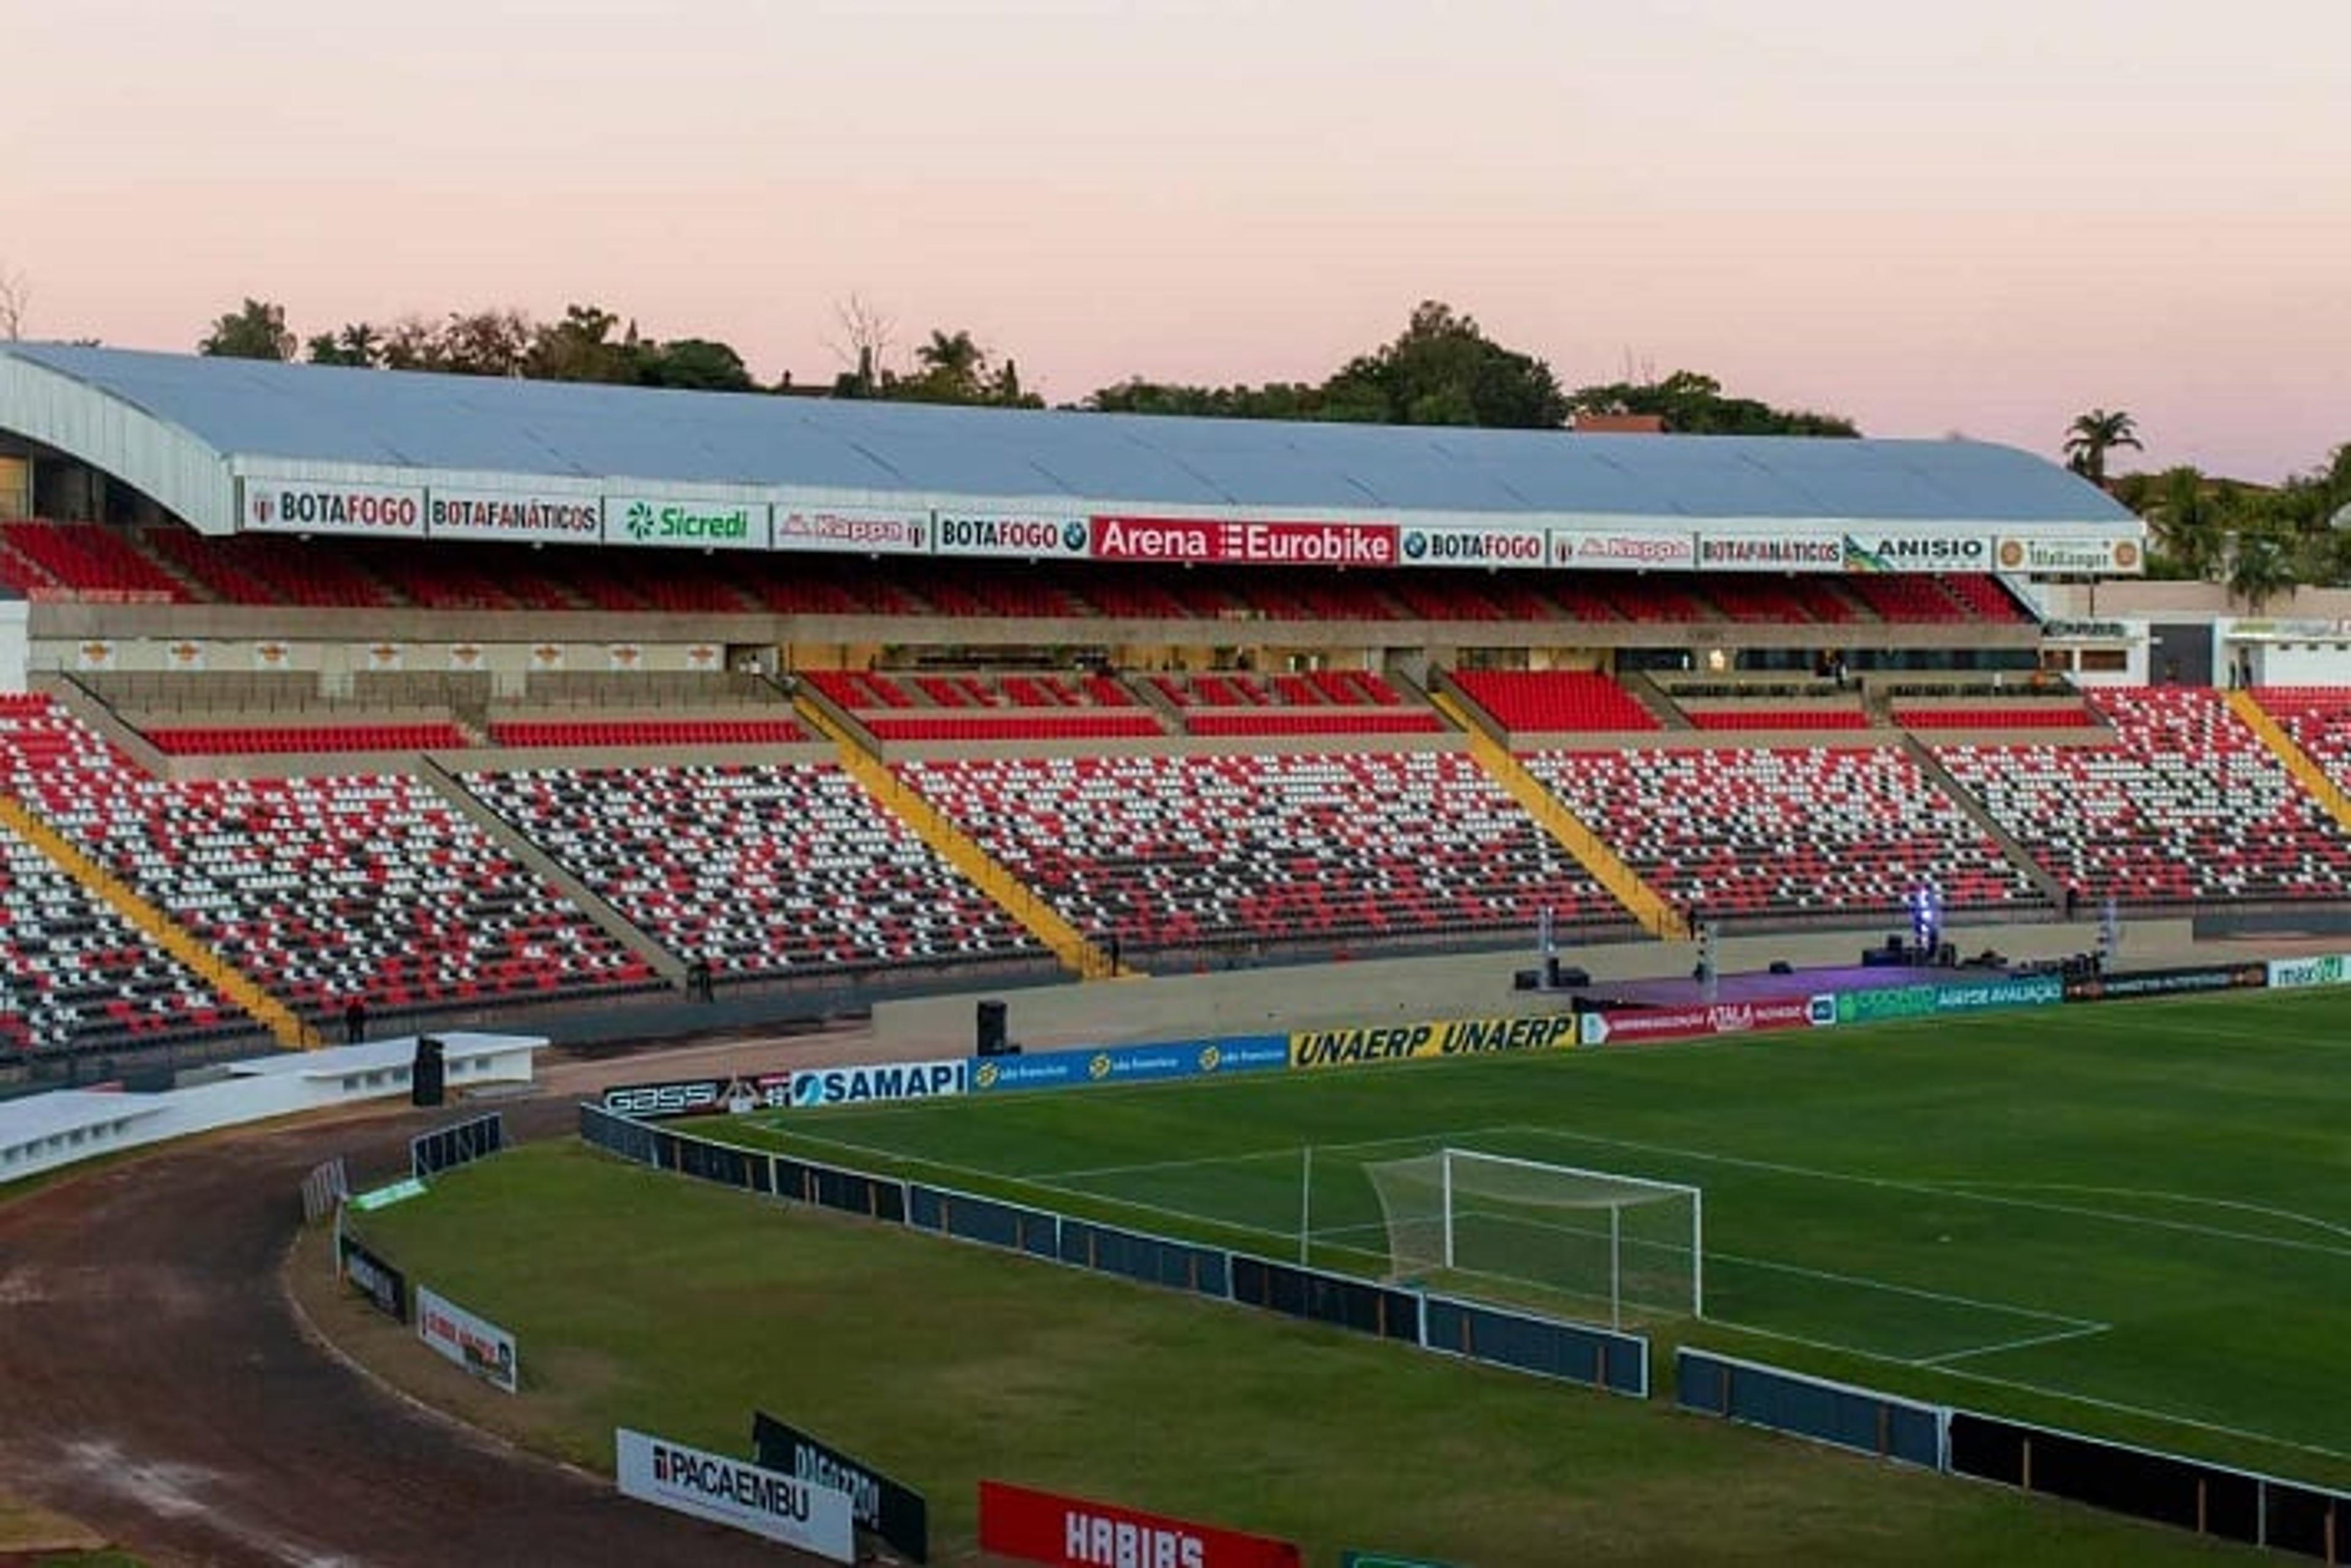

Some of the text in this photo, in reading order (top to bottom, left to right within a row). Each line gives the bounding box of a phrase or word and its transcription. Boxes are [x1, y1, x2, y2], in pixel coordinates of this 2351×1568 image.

[280, 492, 417, 526] BOTAFOGO
[432, 498, 596, 530] BOTAFANÁTICOS
[659, 505, 747, 538] Sicredi
[942, 520, 1058, 549] BOTAFOGO
[1102, 521, 1390, 561] Arena Eurobike
[1431, 534, 1541, 558] BOTAFOGO
[1877, 539, 1983, 557] ANISIO
[1297, 1026, 1433, 1065] UNAERP
[1443, 1017, 1574, 1053] UNAERP
[824, 1065, 966, 1102] SAMAPI
[671, 1451, 810, 1522] PACAEMBU
[1065, 1510, 1203, 1568] HABIB'S
